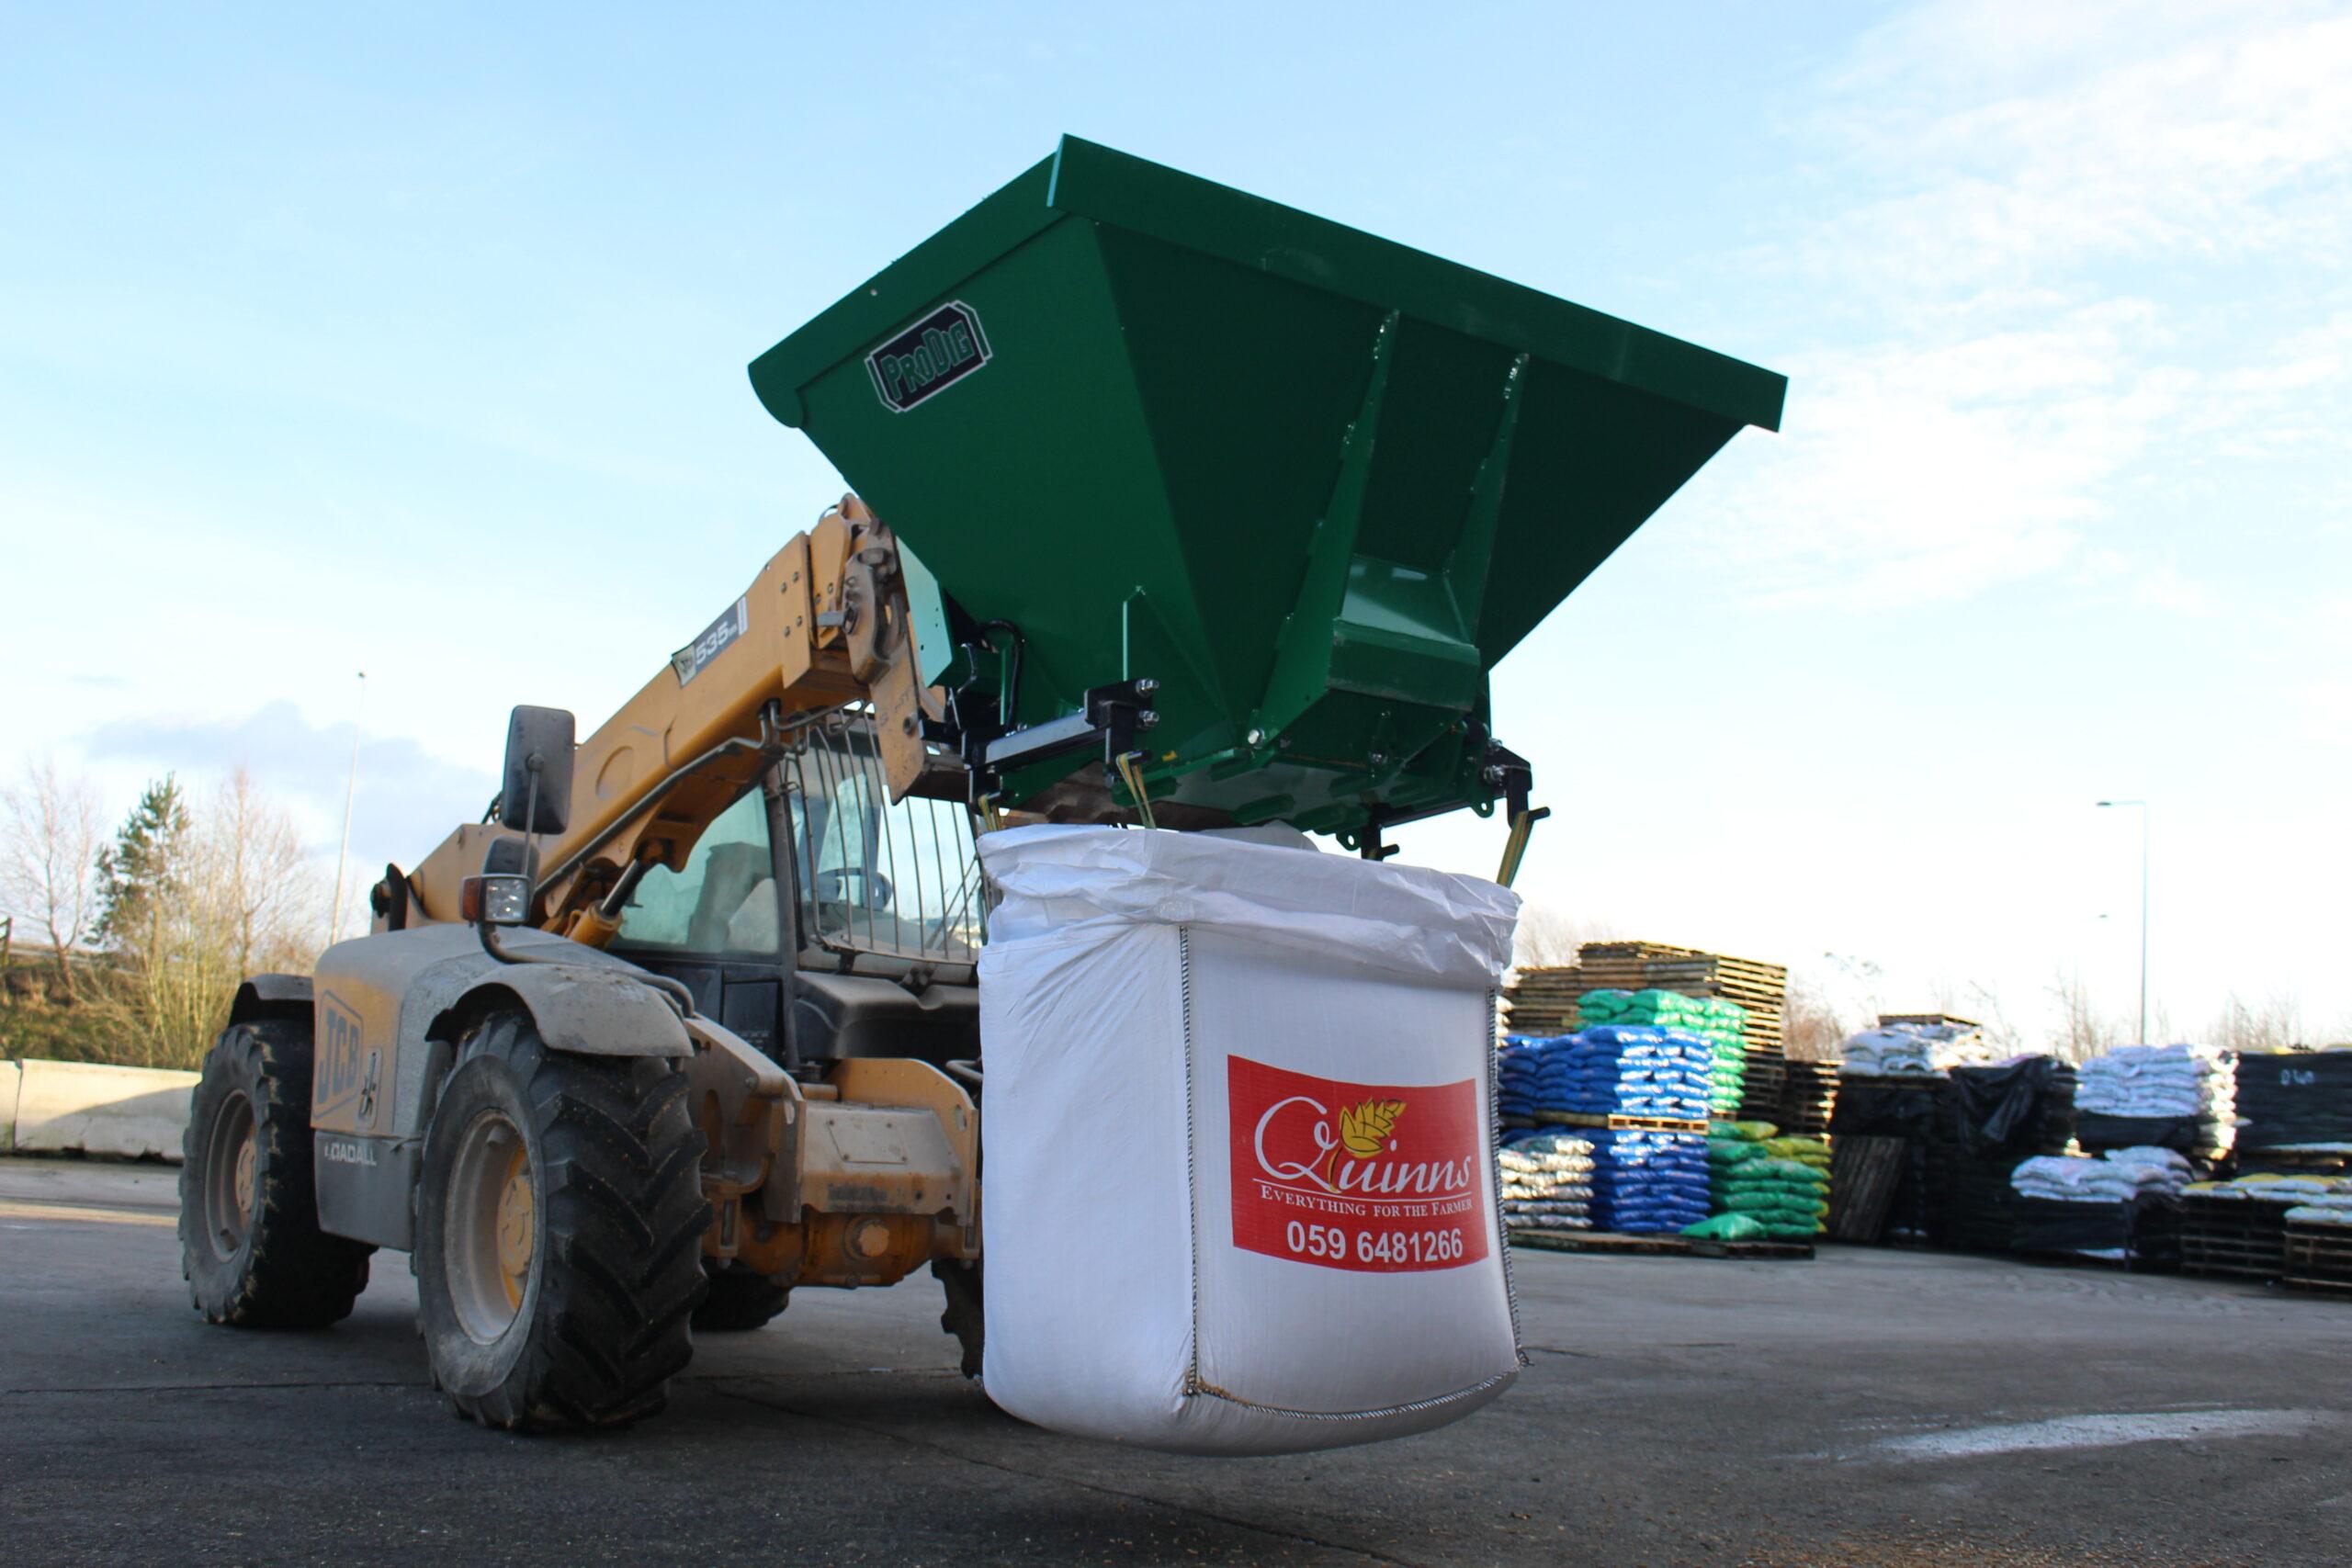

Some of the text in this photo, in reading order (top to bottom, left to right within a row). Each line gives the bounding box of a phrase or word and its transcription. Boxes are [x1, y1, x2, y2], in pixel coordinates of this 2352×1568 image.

[695, 621, 729, 666] 535
[317, 1007, 360, 1105] JCB
[1254, 1095, 1472, 1194] Quinns
[1260, 1184, 1474, 1218] EVERYTHING FOR THE FARMER
[1286, 1220, 1464, 1264] 059 6481266
